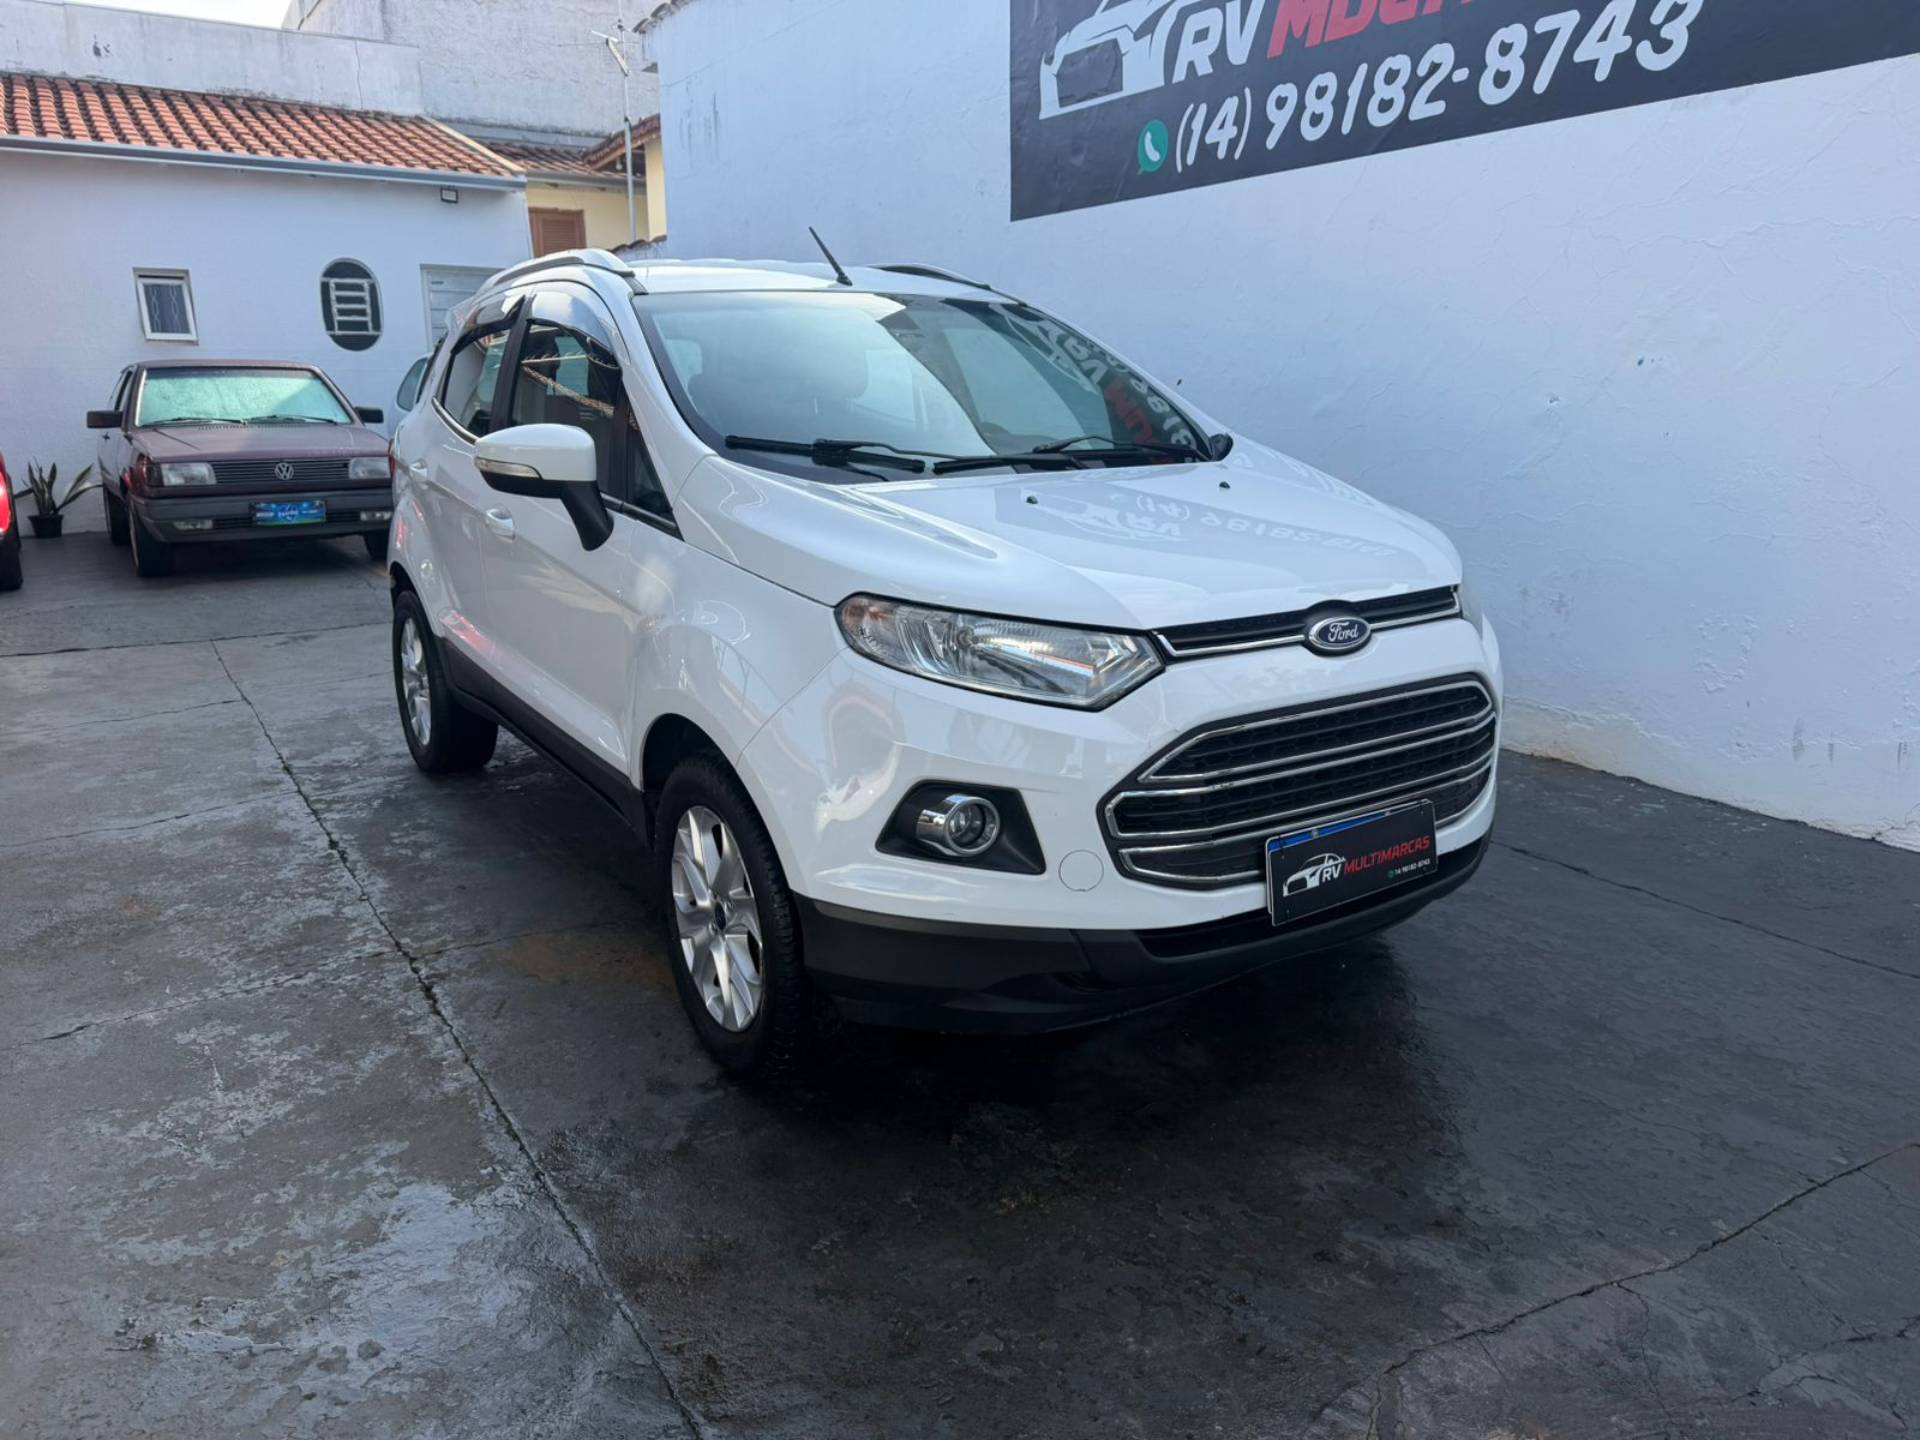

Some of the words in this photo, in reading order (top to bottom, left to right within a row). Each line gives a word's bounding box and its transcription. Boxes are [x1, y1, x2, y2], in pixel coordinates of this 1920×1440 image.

[1172, 0, 1265, 84] RV
[1176, 87, 1252, 173] (14)
[1265, 0, 1702, 150] 98182-8743
[1327, 621, 1359, 642] Ford
[1322, 864, 1342, 882] RV
[1344, 835, 1431, 874] MULTIMARCAS
